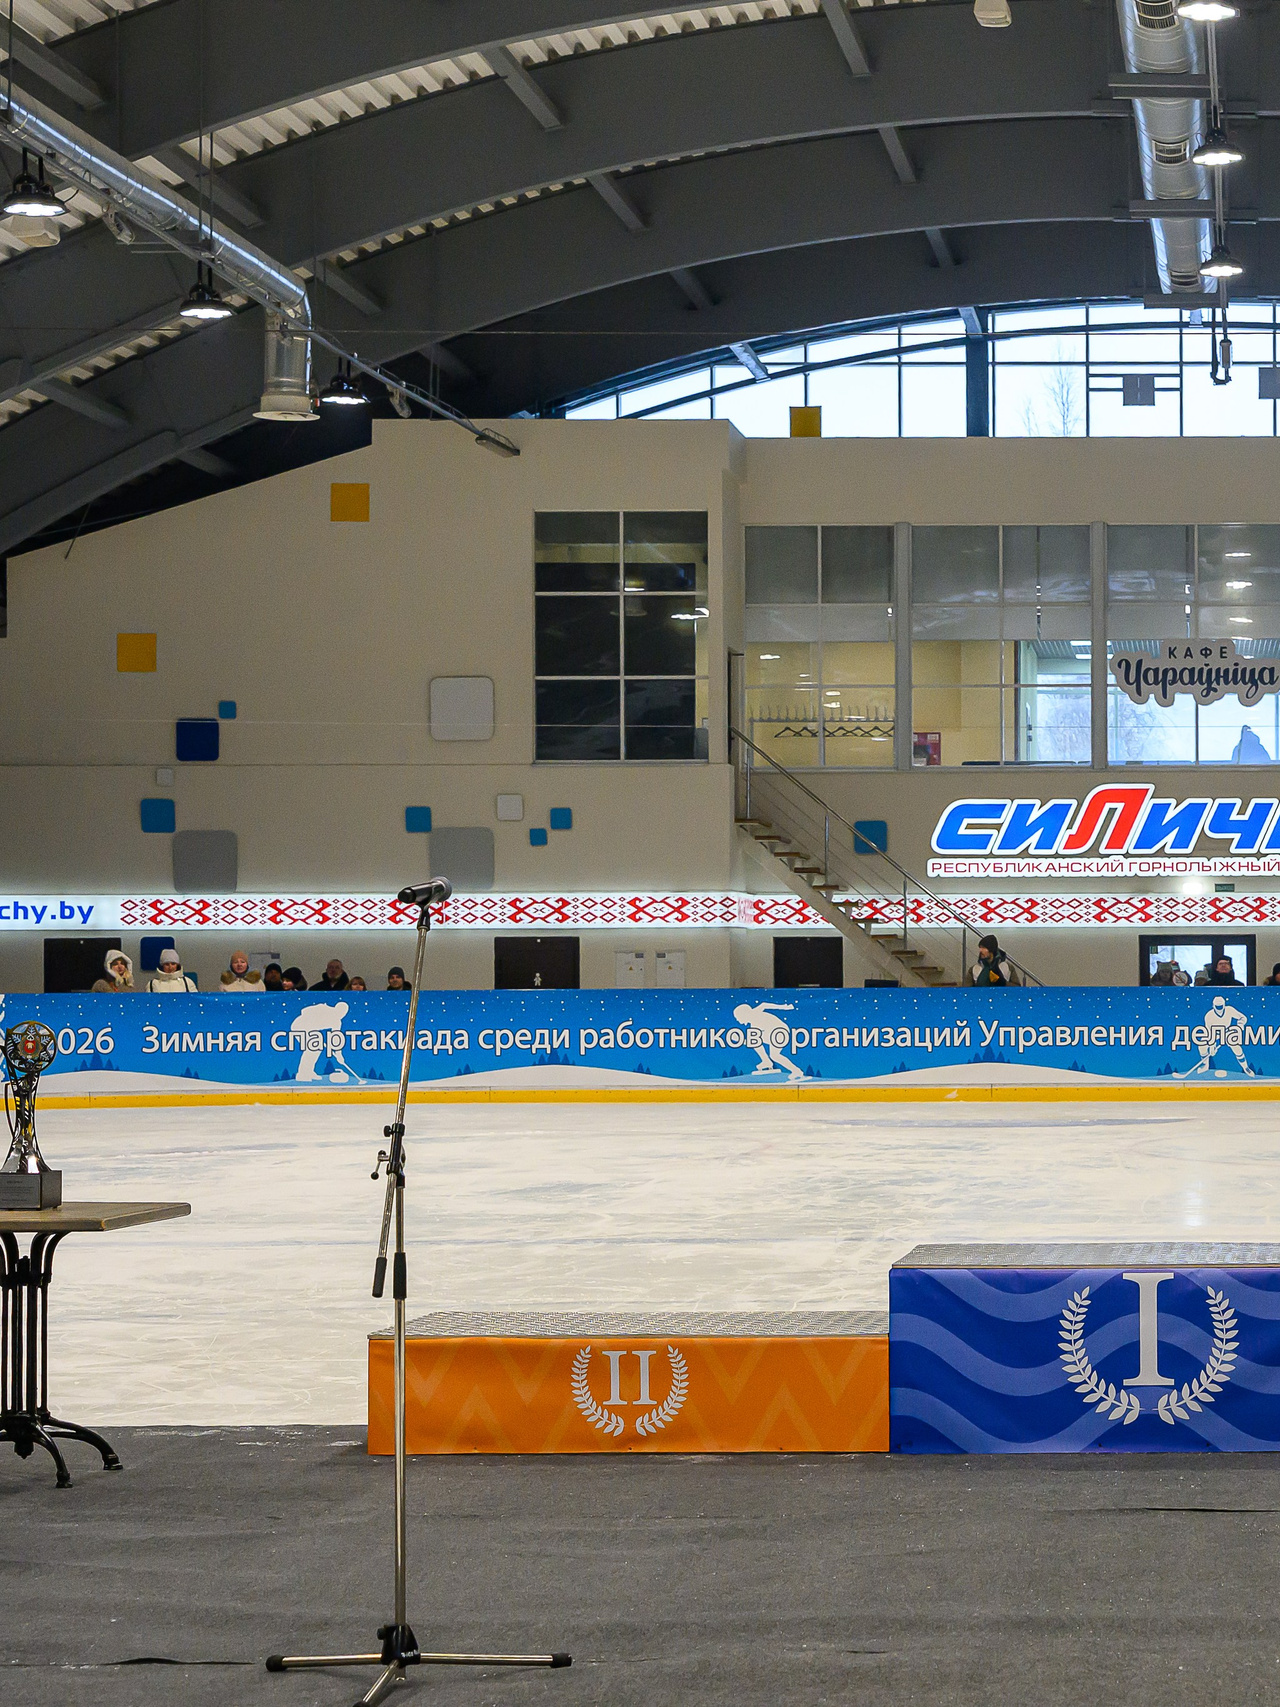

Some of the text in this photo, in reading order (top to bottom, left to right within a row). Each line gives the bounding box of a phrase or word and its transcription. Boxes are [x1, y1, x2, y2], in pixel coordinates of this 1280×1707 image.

[1168, 646, 1228, 659] КАФЕ
[1117, 658, 1279, 699] Чараўніца
[931, 859, 1124, 873] РЕСПУБЛИКАНСКИЙ
[1128, 858, 1280, 872] ГОРНОЛЫЖНЫЙ
[0, 901, 94, 924] chy.by
[57, 1027, 115, 1055] 026
[142, 1025, 262, 1053] Зимняя
[270, 1027, 470, 1057] спартакиада
[478, 1027, 570, 1056] среди
[579, 1021, 764, 1056] работников
[769, 1020, 971, 1053] организаций
[978, 1020, 1163, 1053] Управления
[1122, 1272, 1175, 1386] I
[602, 1350, 657, 1405] II
